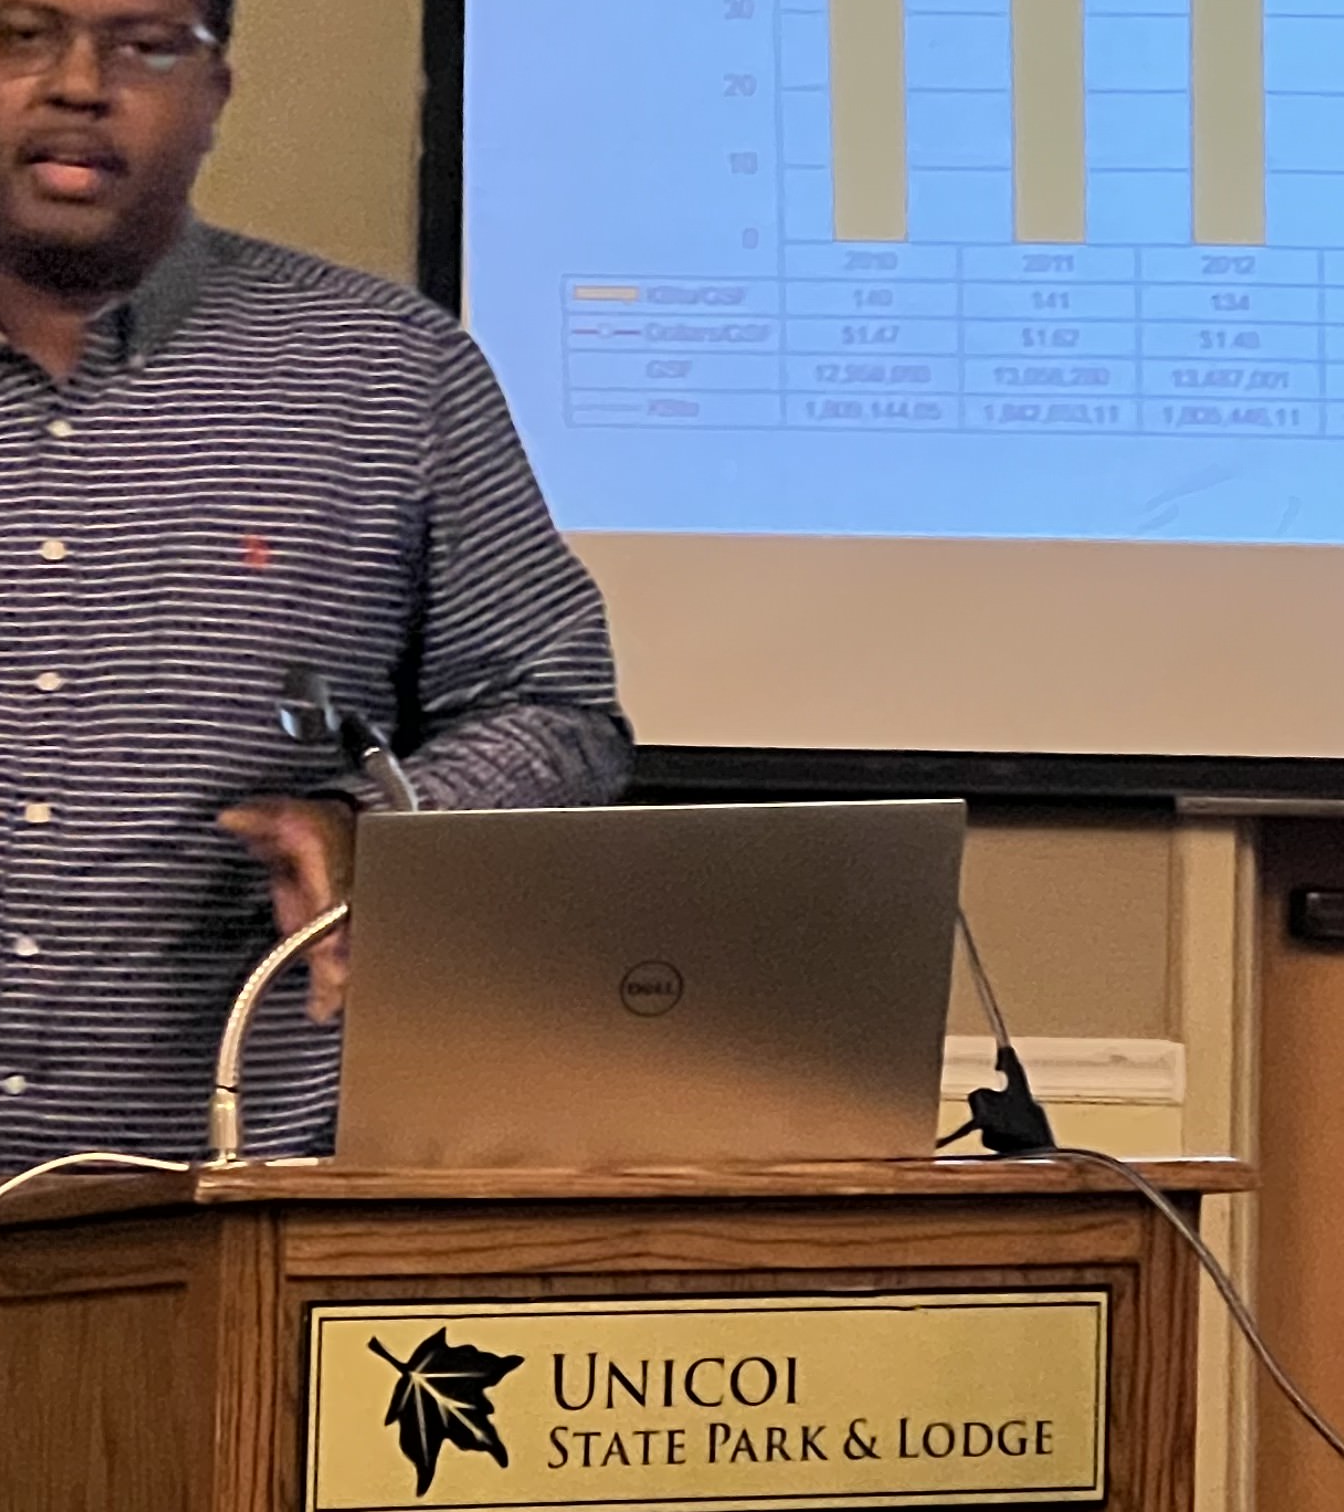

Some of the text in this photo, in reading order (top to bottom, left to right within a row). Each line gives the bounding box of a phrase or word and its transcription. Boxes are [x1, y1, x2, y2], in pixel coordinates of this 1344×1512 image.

[723, 73, 756, 97] 20
[729, 152, 758, 175] 10
[1022, 254, 1075, 272] 2011
[1201, 255, 1255, 275] 2012
[842, 1416, 882, 1460] &
